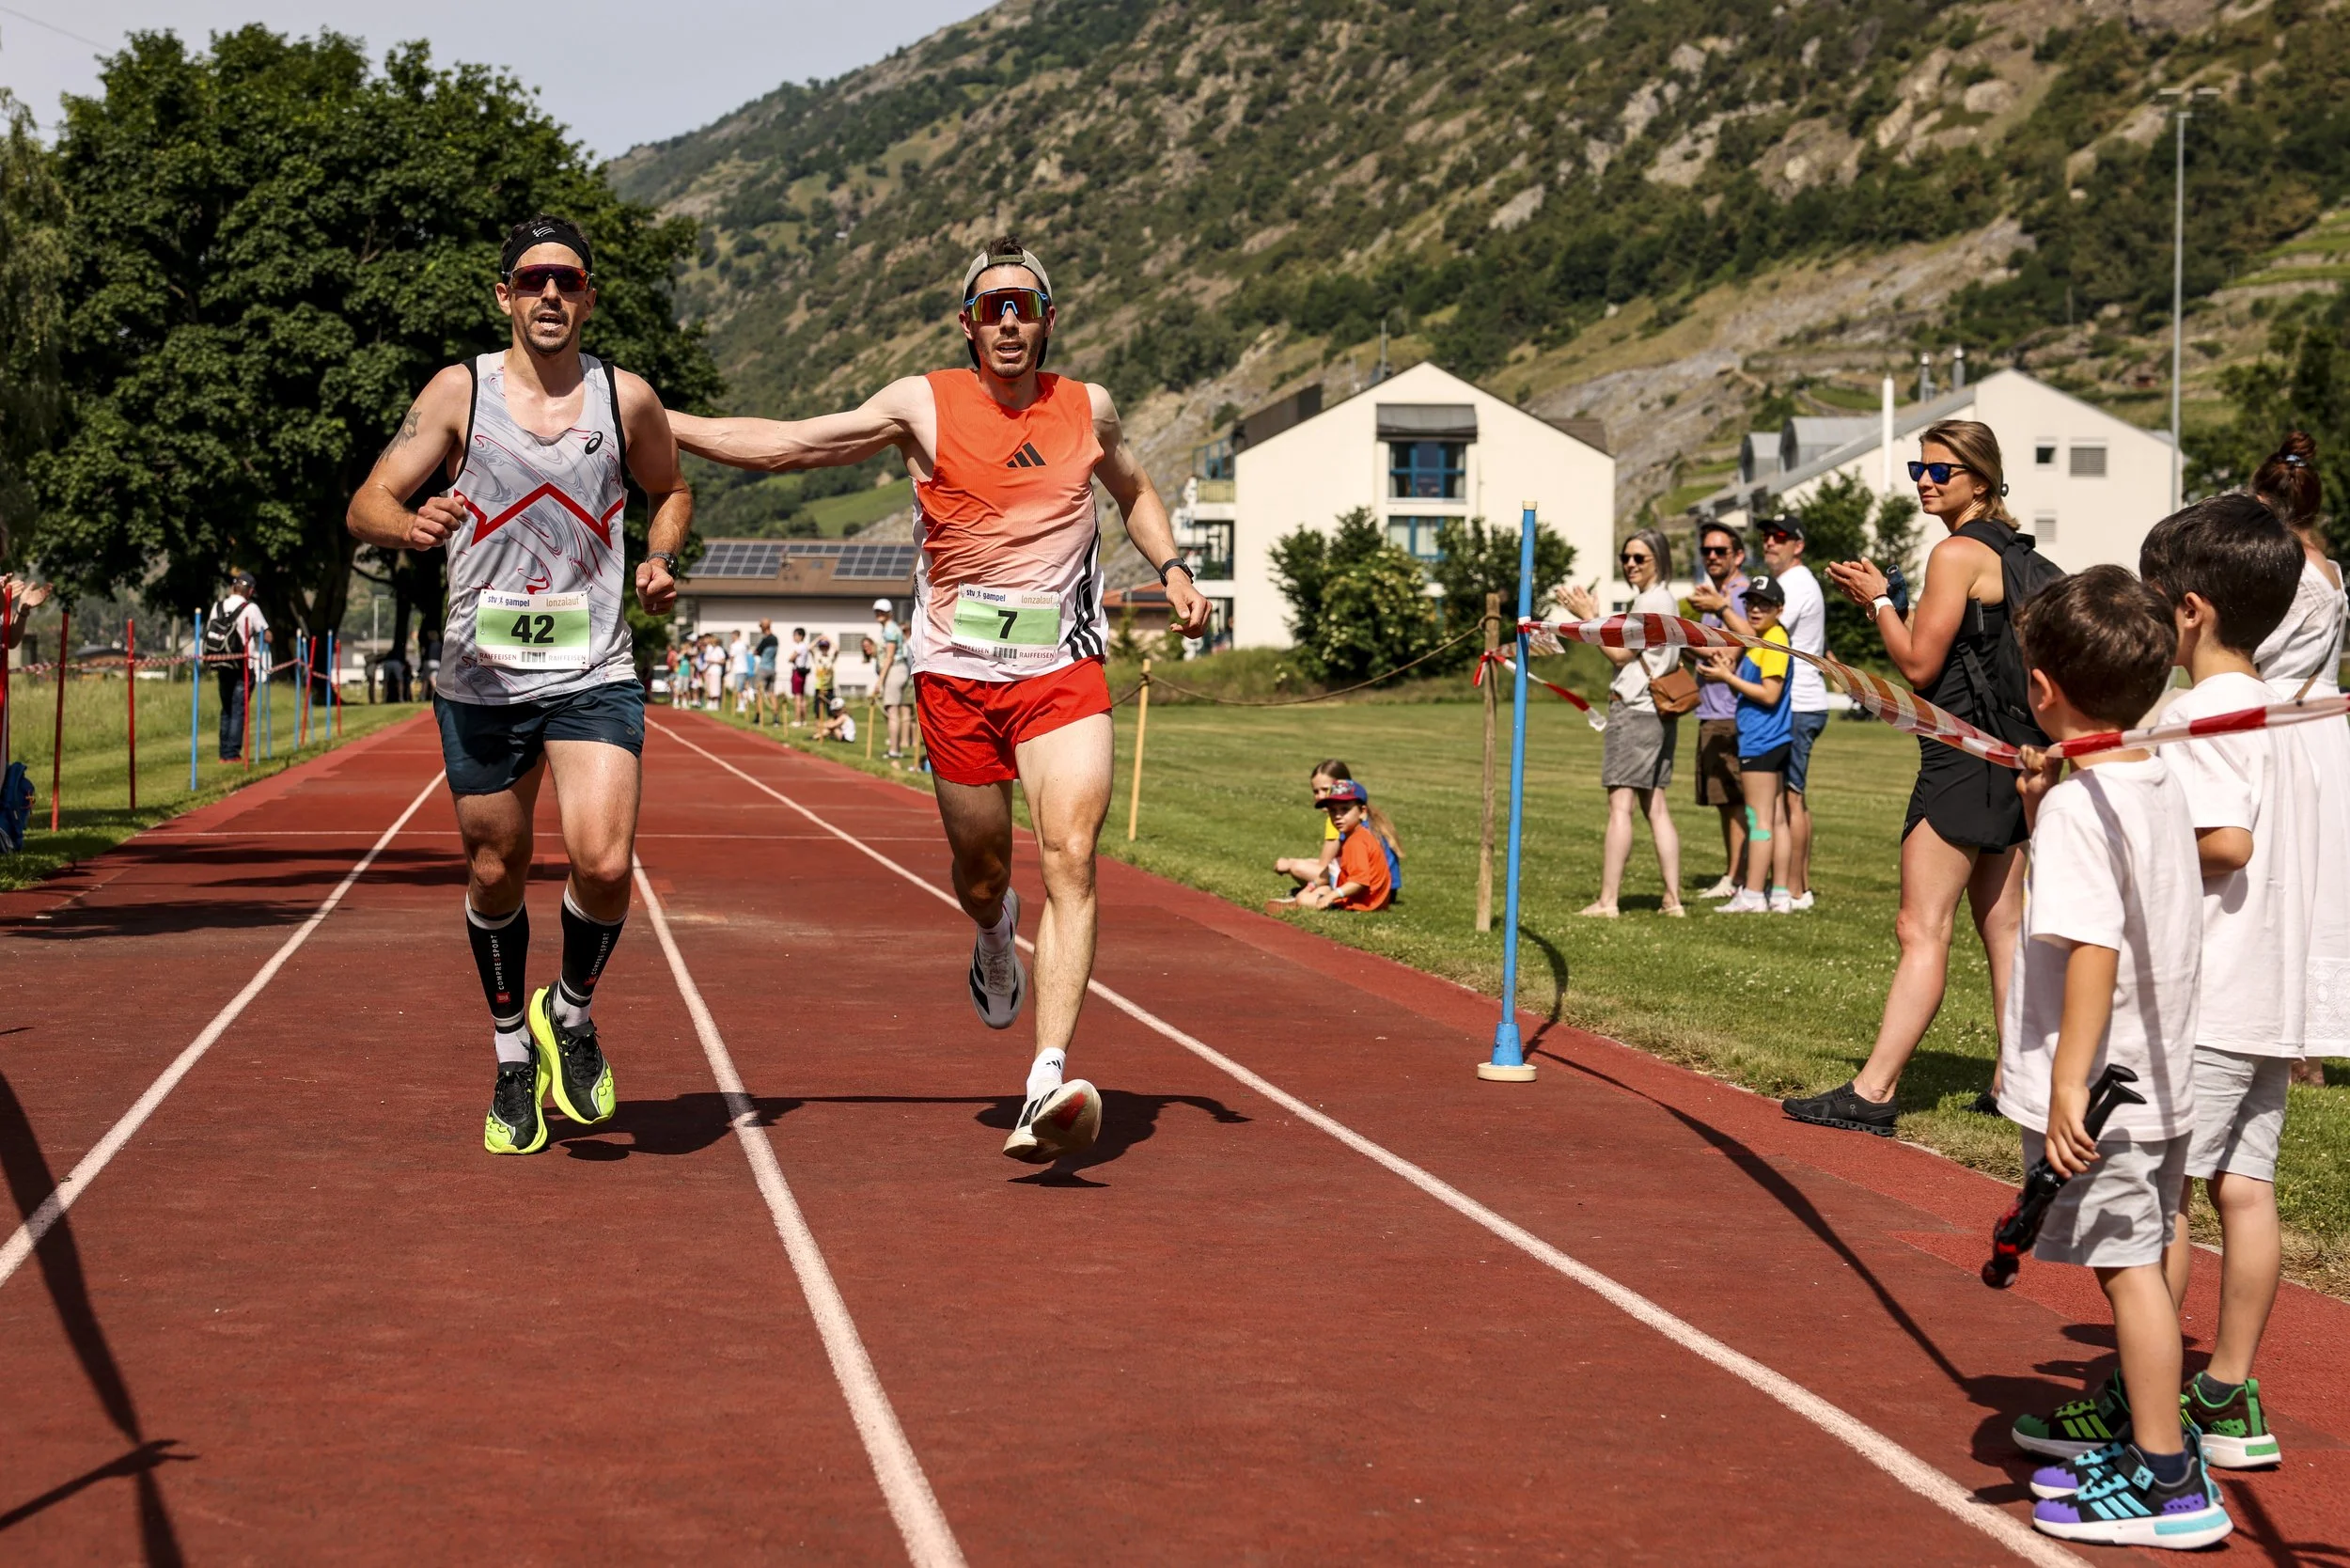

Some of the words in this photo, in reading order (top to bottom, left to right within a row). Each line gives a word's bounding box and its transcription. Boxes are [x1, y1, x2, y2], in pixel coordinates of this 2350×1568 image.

[966, 588, 976, 597] stv
[982, 592, 1006, 603] gampel
[1021, 594, 1054, 604] lonzalauf
[505, 598, 530, 607] gampel
[546, 596, 579, 606] lonzalauf
[997, 609, 1018, 639] 7
[510, 615, 555, 644] 42
[479, 652, 517, 661] RAIFFEISEN
